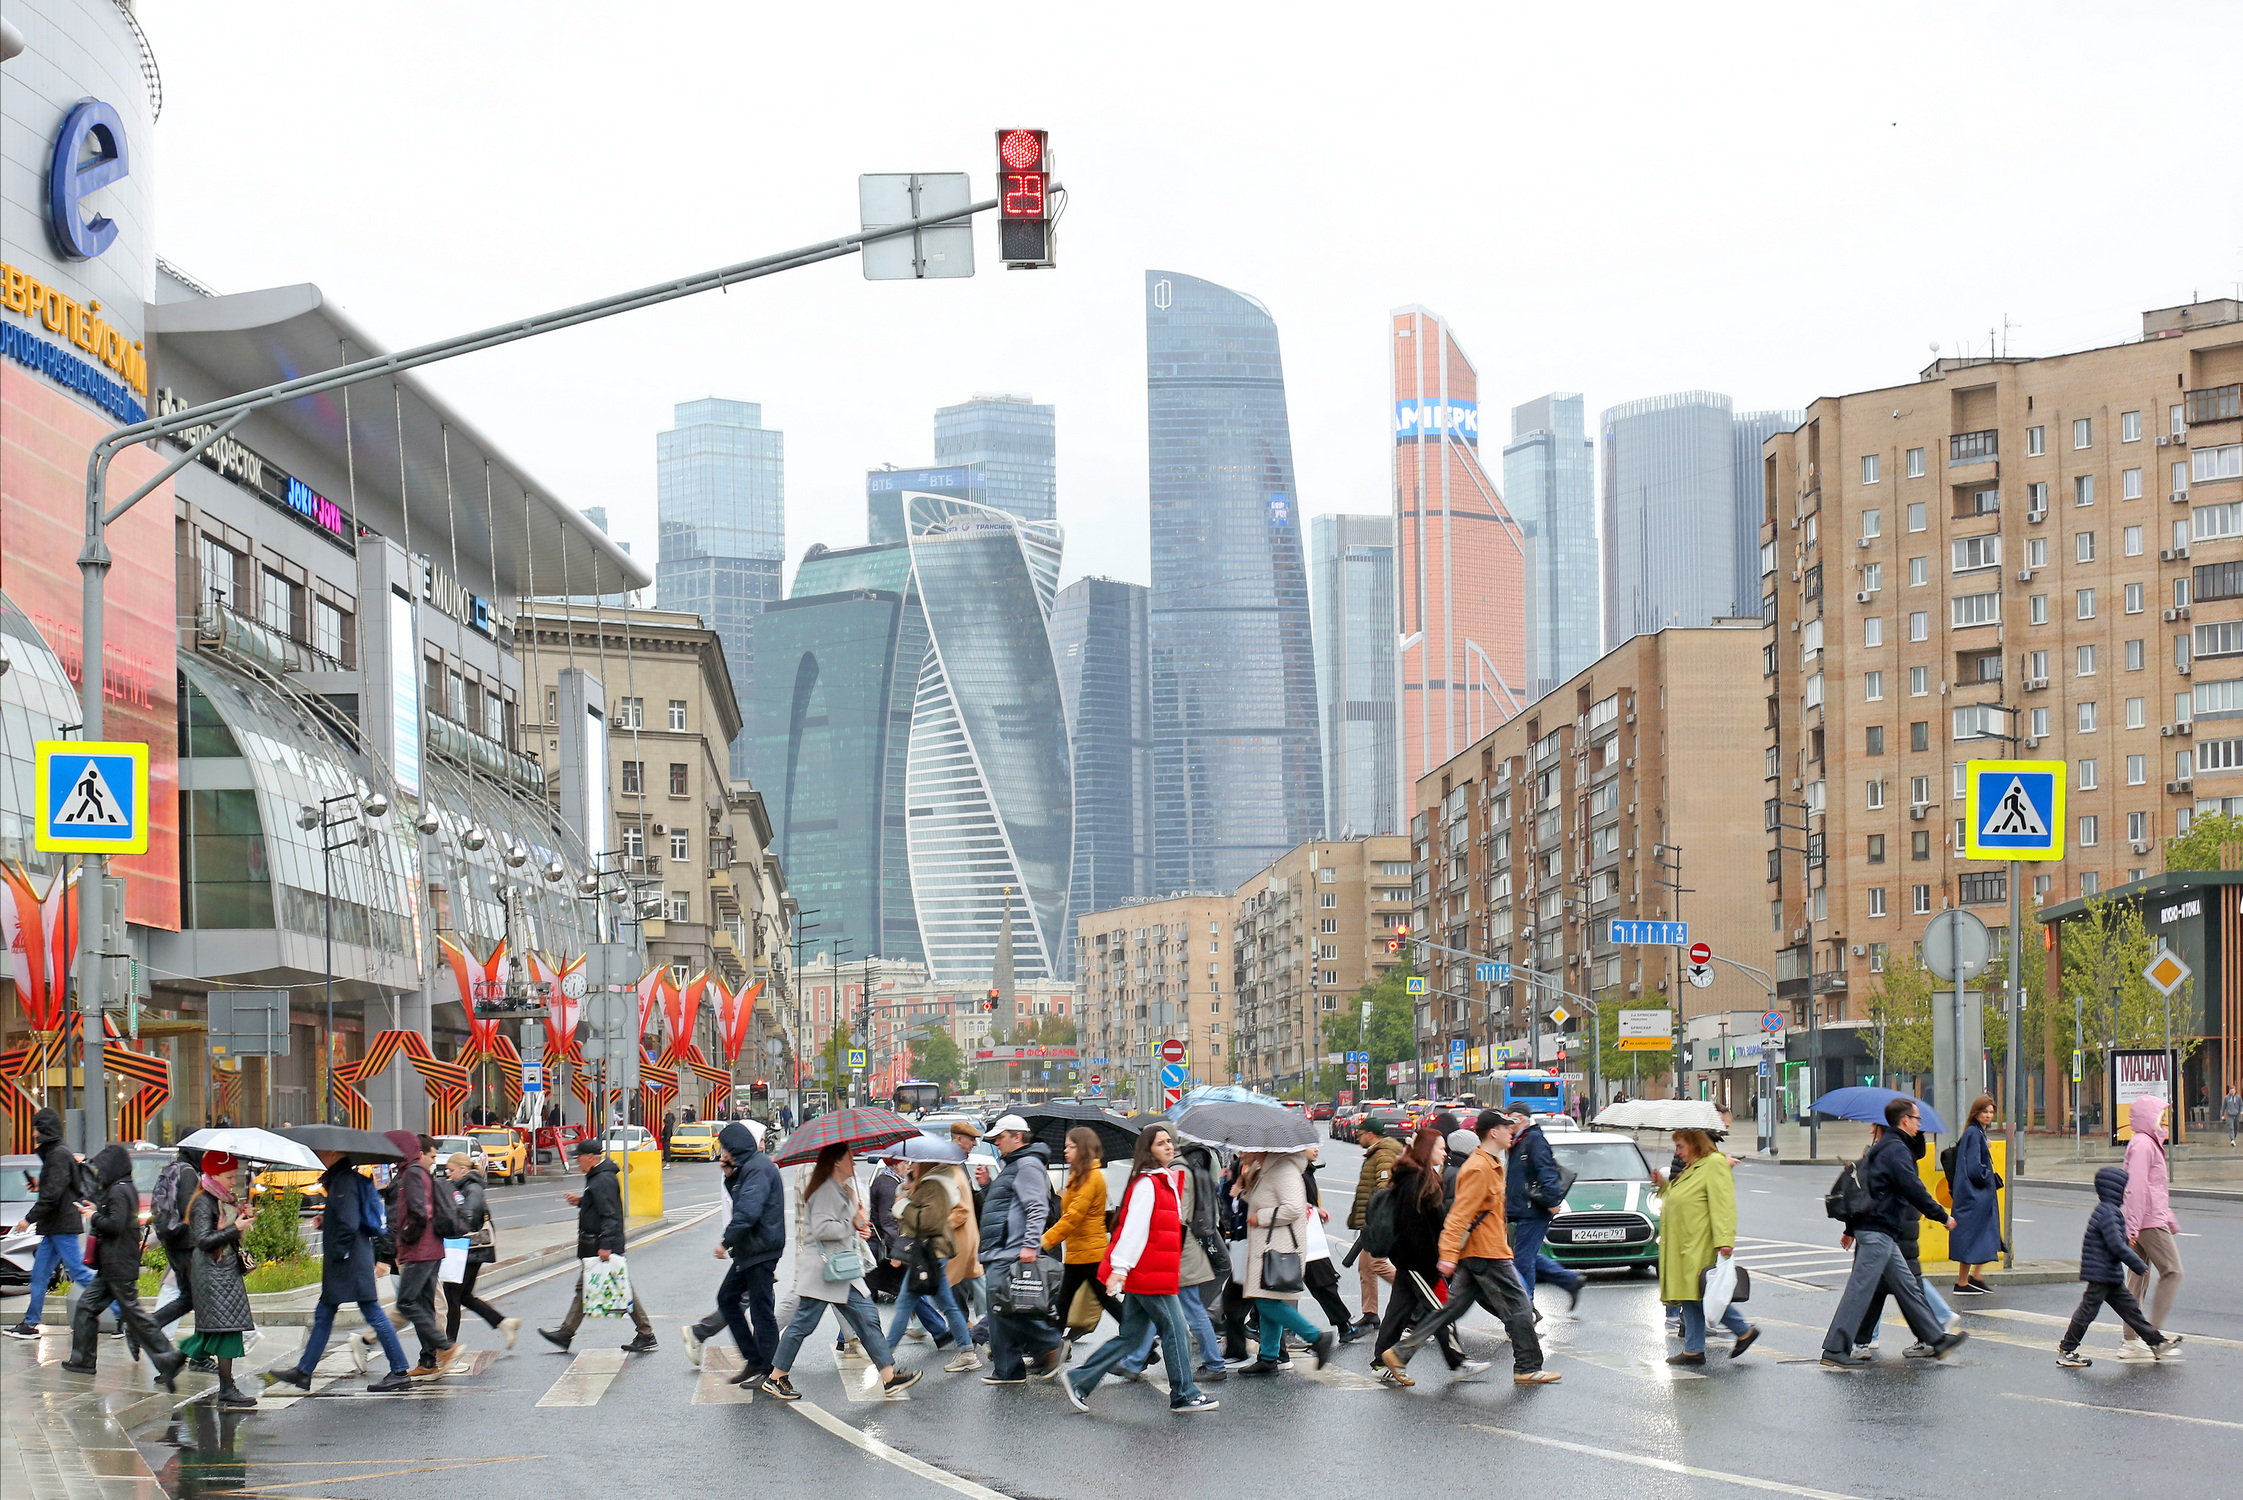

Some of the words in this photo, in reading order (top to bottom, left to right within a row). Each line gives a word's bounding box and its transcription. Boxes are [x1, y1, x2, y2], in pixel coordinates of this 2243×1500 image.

[1007, 175, 1042, 215] 29
[872, 479, 893, 491] ВТБ
[930, 474, 954, 487] ВТБ
[288, 476, 313, 517] JOKI
[318, 496, 342, 534] JOYA
[432, 561, 470, 625] MUDO
[33, 610, 152, 711] РОБДЕНИЕ
[2121, 1055, 2168, 1082] MACAN
[1610, 1229, 1624, 1237] 797
